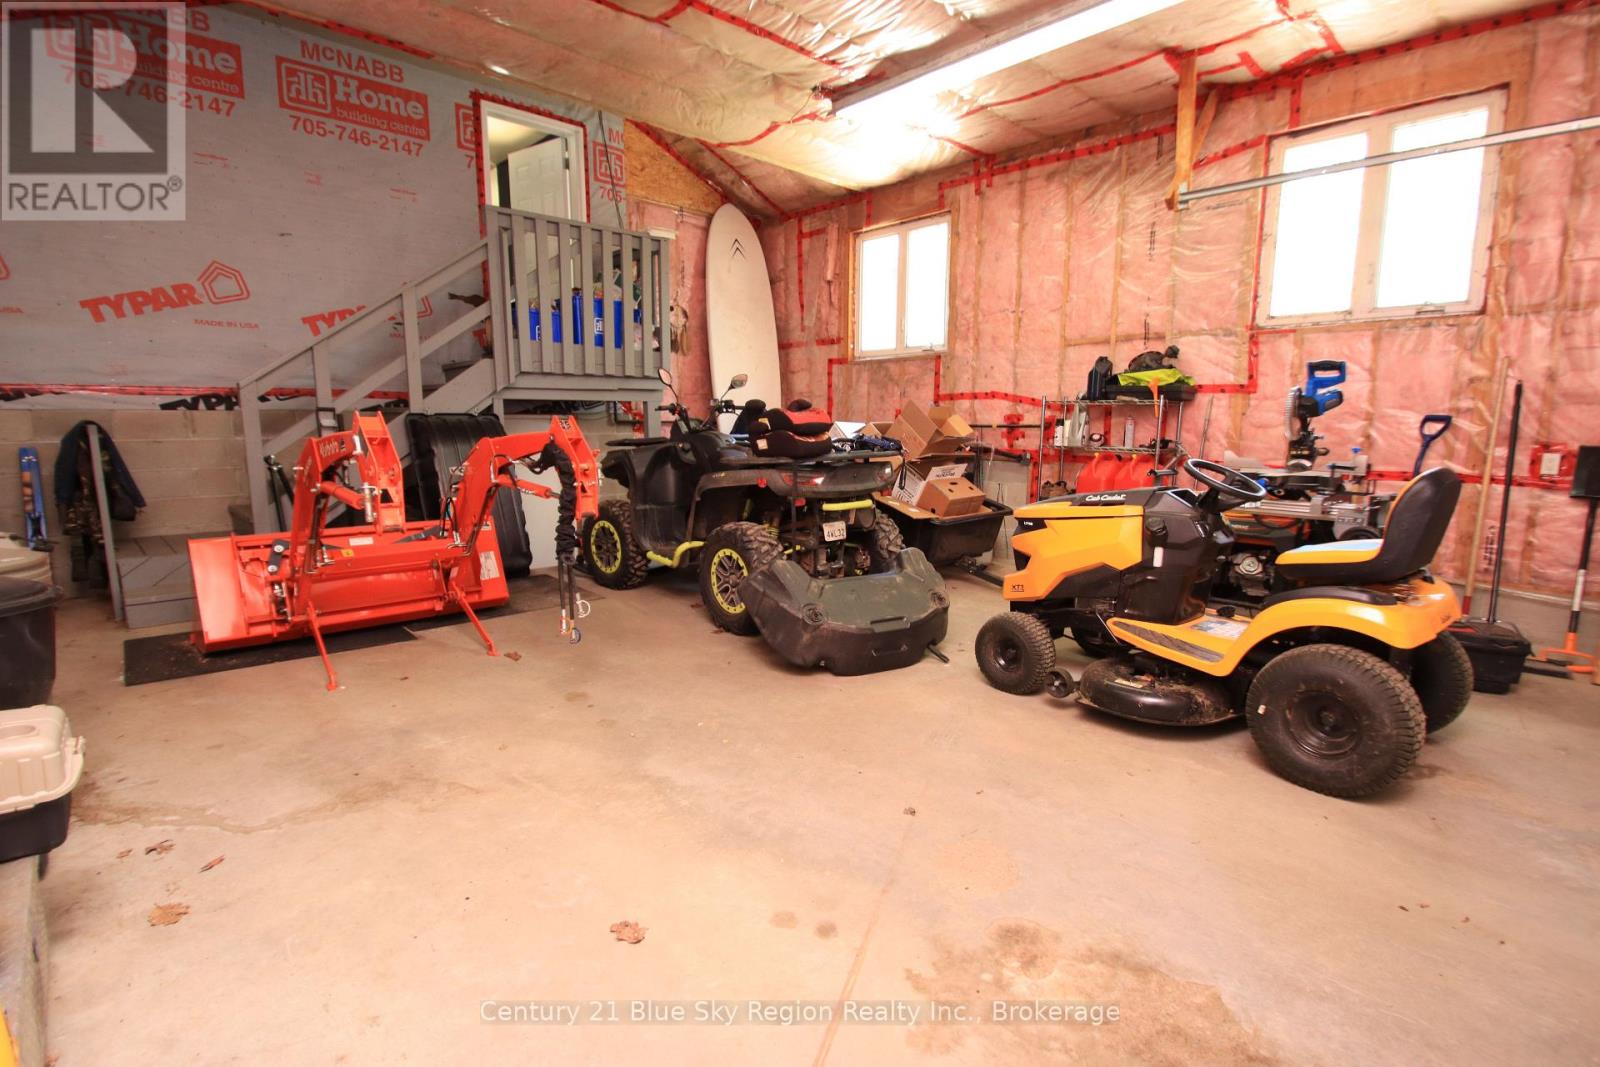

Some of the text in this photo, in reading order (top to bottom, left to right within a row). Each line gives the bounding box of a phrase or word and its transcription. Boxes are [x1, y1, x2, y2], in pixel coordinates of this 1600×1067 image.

[334, 74, 425, 120] Home
[335, 106, 387, 129] building
[289, 115, 424, 157] 705-746-2147
[79, 283, 203, 324] TYPAR
[192, 318, 260, 330] MADE IN USA
